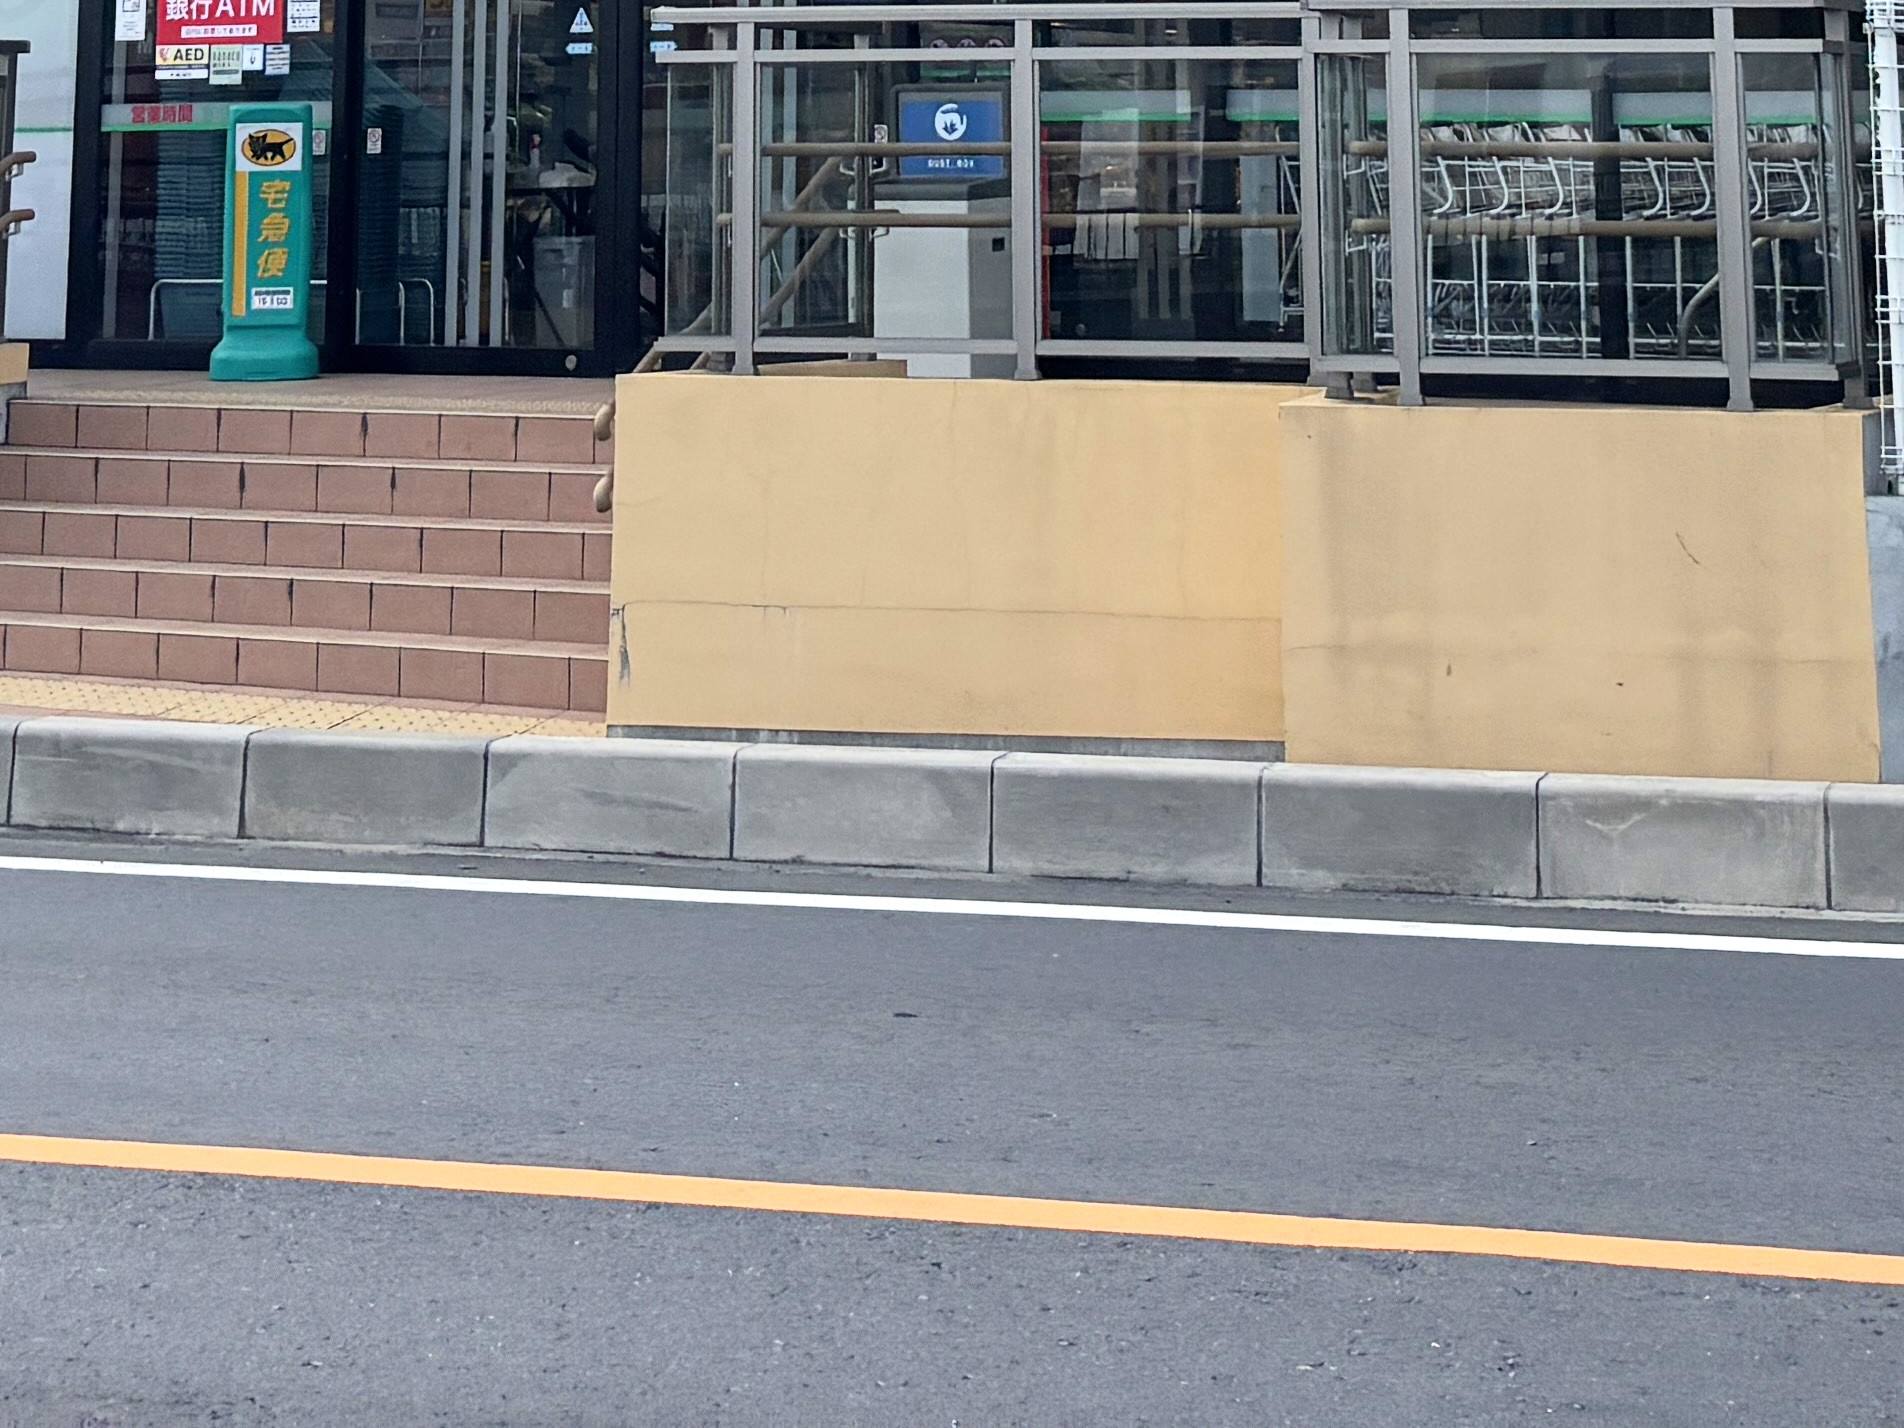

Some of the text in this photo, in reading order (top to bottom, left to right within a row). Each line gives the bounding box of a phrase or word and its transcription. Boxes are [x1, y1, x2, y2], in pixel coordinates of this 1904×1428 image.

[173, 47, 205, 62] AED
[131, 105, 193, 123] 営業時間
[257, 180, 291, 278] 宅急便
